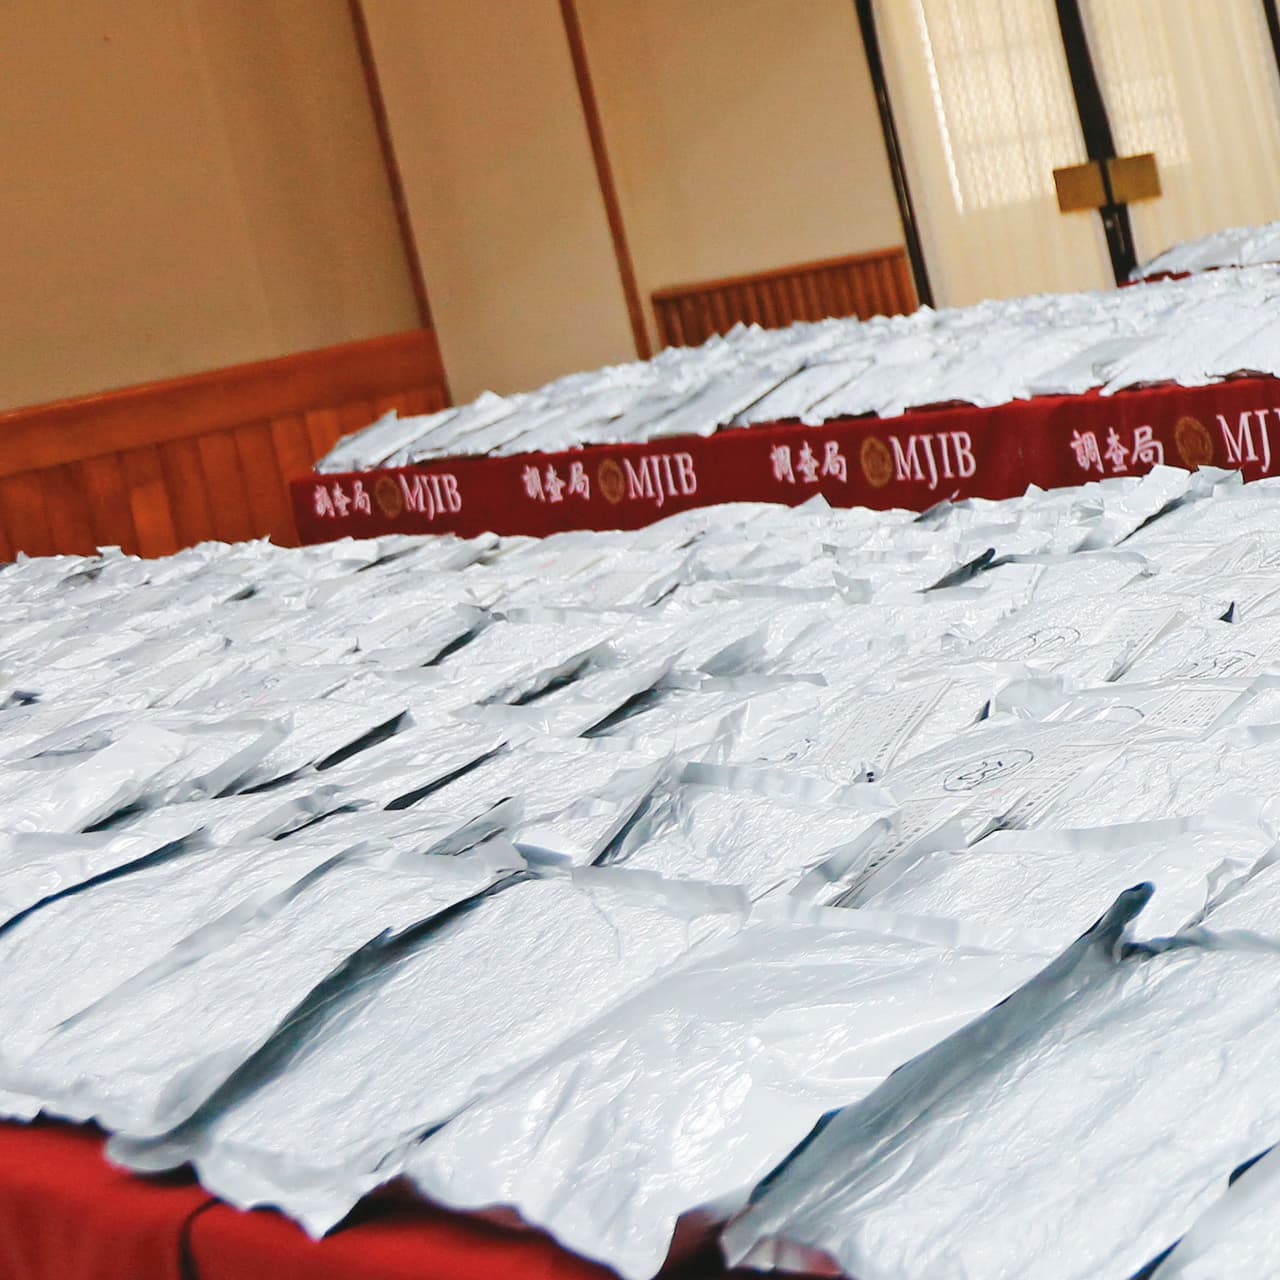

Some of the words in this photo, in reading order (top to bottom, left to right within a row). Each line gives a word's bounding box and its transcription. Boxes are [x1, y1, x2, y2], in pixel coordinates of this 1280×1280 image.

[770, 440, 848, 486] 調查局
[890, 430, 977, 490] MJIB
[1070, 424, 1164, 473] 調查局
[398, 473, 463, 521] MJIB
[522, 460, 590, 503] 調查局
[624, 452, 697, 508] MJIB
